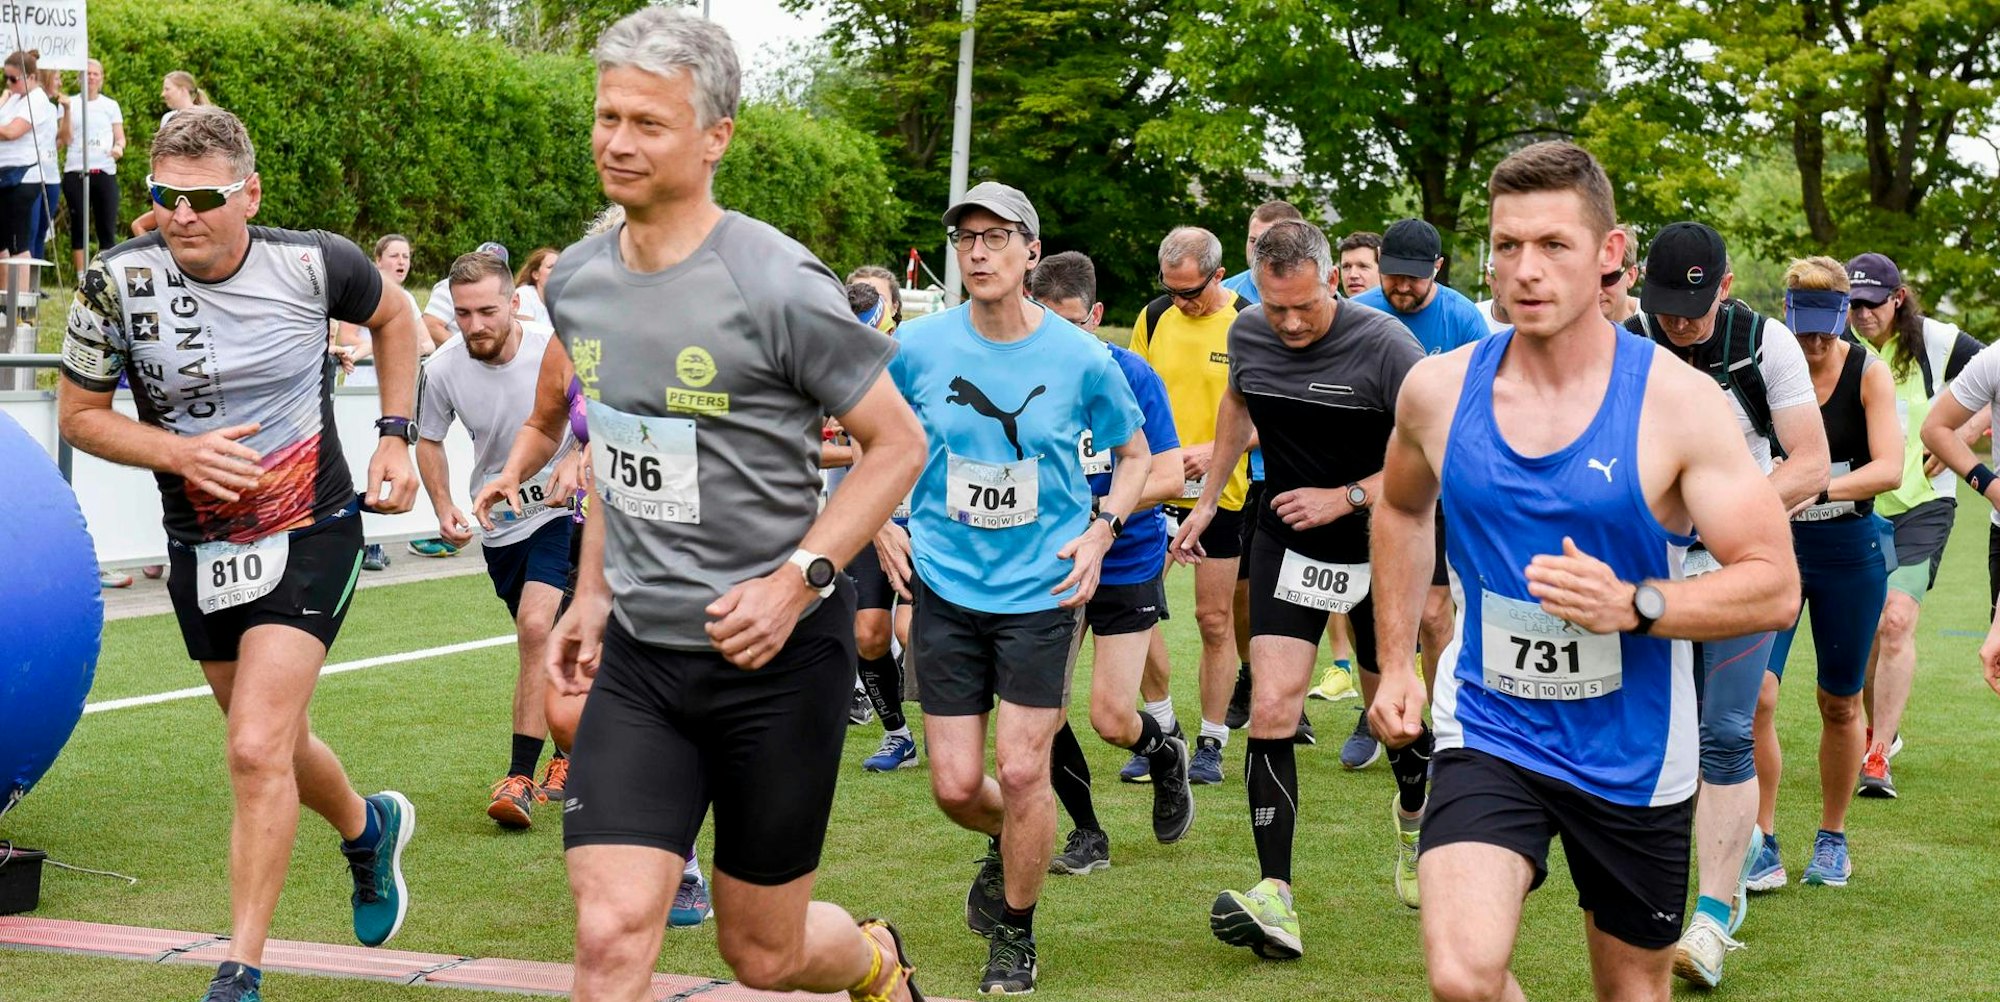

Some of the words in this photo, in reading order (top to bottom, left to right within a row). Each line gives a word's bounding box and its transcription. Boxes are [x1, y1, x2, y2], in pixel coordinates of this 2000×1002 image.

[0, 4, 21, 24] ER
[25, 6, 76, 27] FOKUS
[305, 264, 321, 296] Reebok
[166, 268, 216, 419] CHANGE
[669, 391, 726, 407] PETERS
[605, 443, 662, 492] 756
[506, 485, 545, 506] 18
[968, 483, 1017, 511] 704
[626, 501, 638, 513] 10
[643, 503, 657, 515] W
[667, 505, 675, 517] 5
[1808, 511, 1818, 519] 10
[1821, 510, 1830, 518] W
[973, 516, 980, 524] K
[987, 518, 997, 527] 10
[1001, 517, 1011, 525] W
[212, 553, 262, 588] 810
[1301, 565, 1350, 594] 908
[220, 596, 227, 605] K
[232, 592, 242, 602] 10
[246, 590, 257, 599] W
[1303, 595, 1310, 603] K
[1316, 598, 1326, 607] 10
[1329, 600, 1339, 609] W
[1510, 635, 1580, 674] 731
[1522, 683, 1531, 694] K
[1541, 686, 1556, 696] 10
[1563, 686, 1578, 696] W
[1589, 683, 1598, 694] 5
